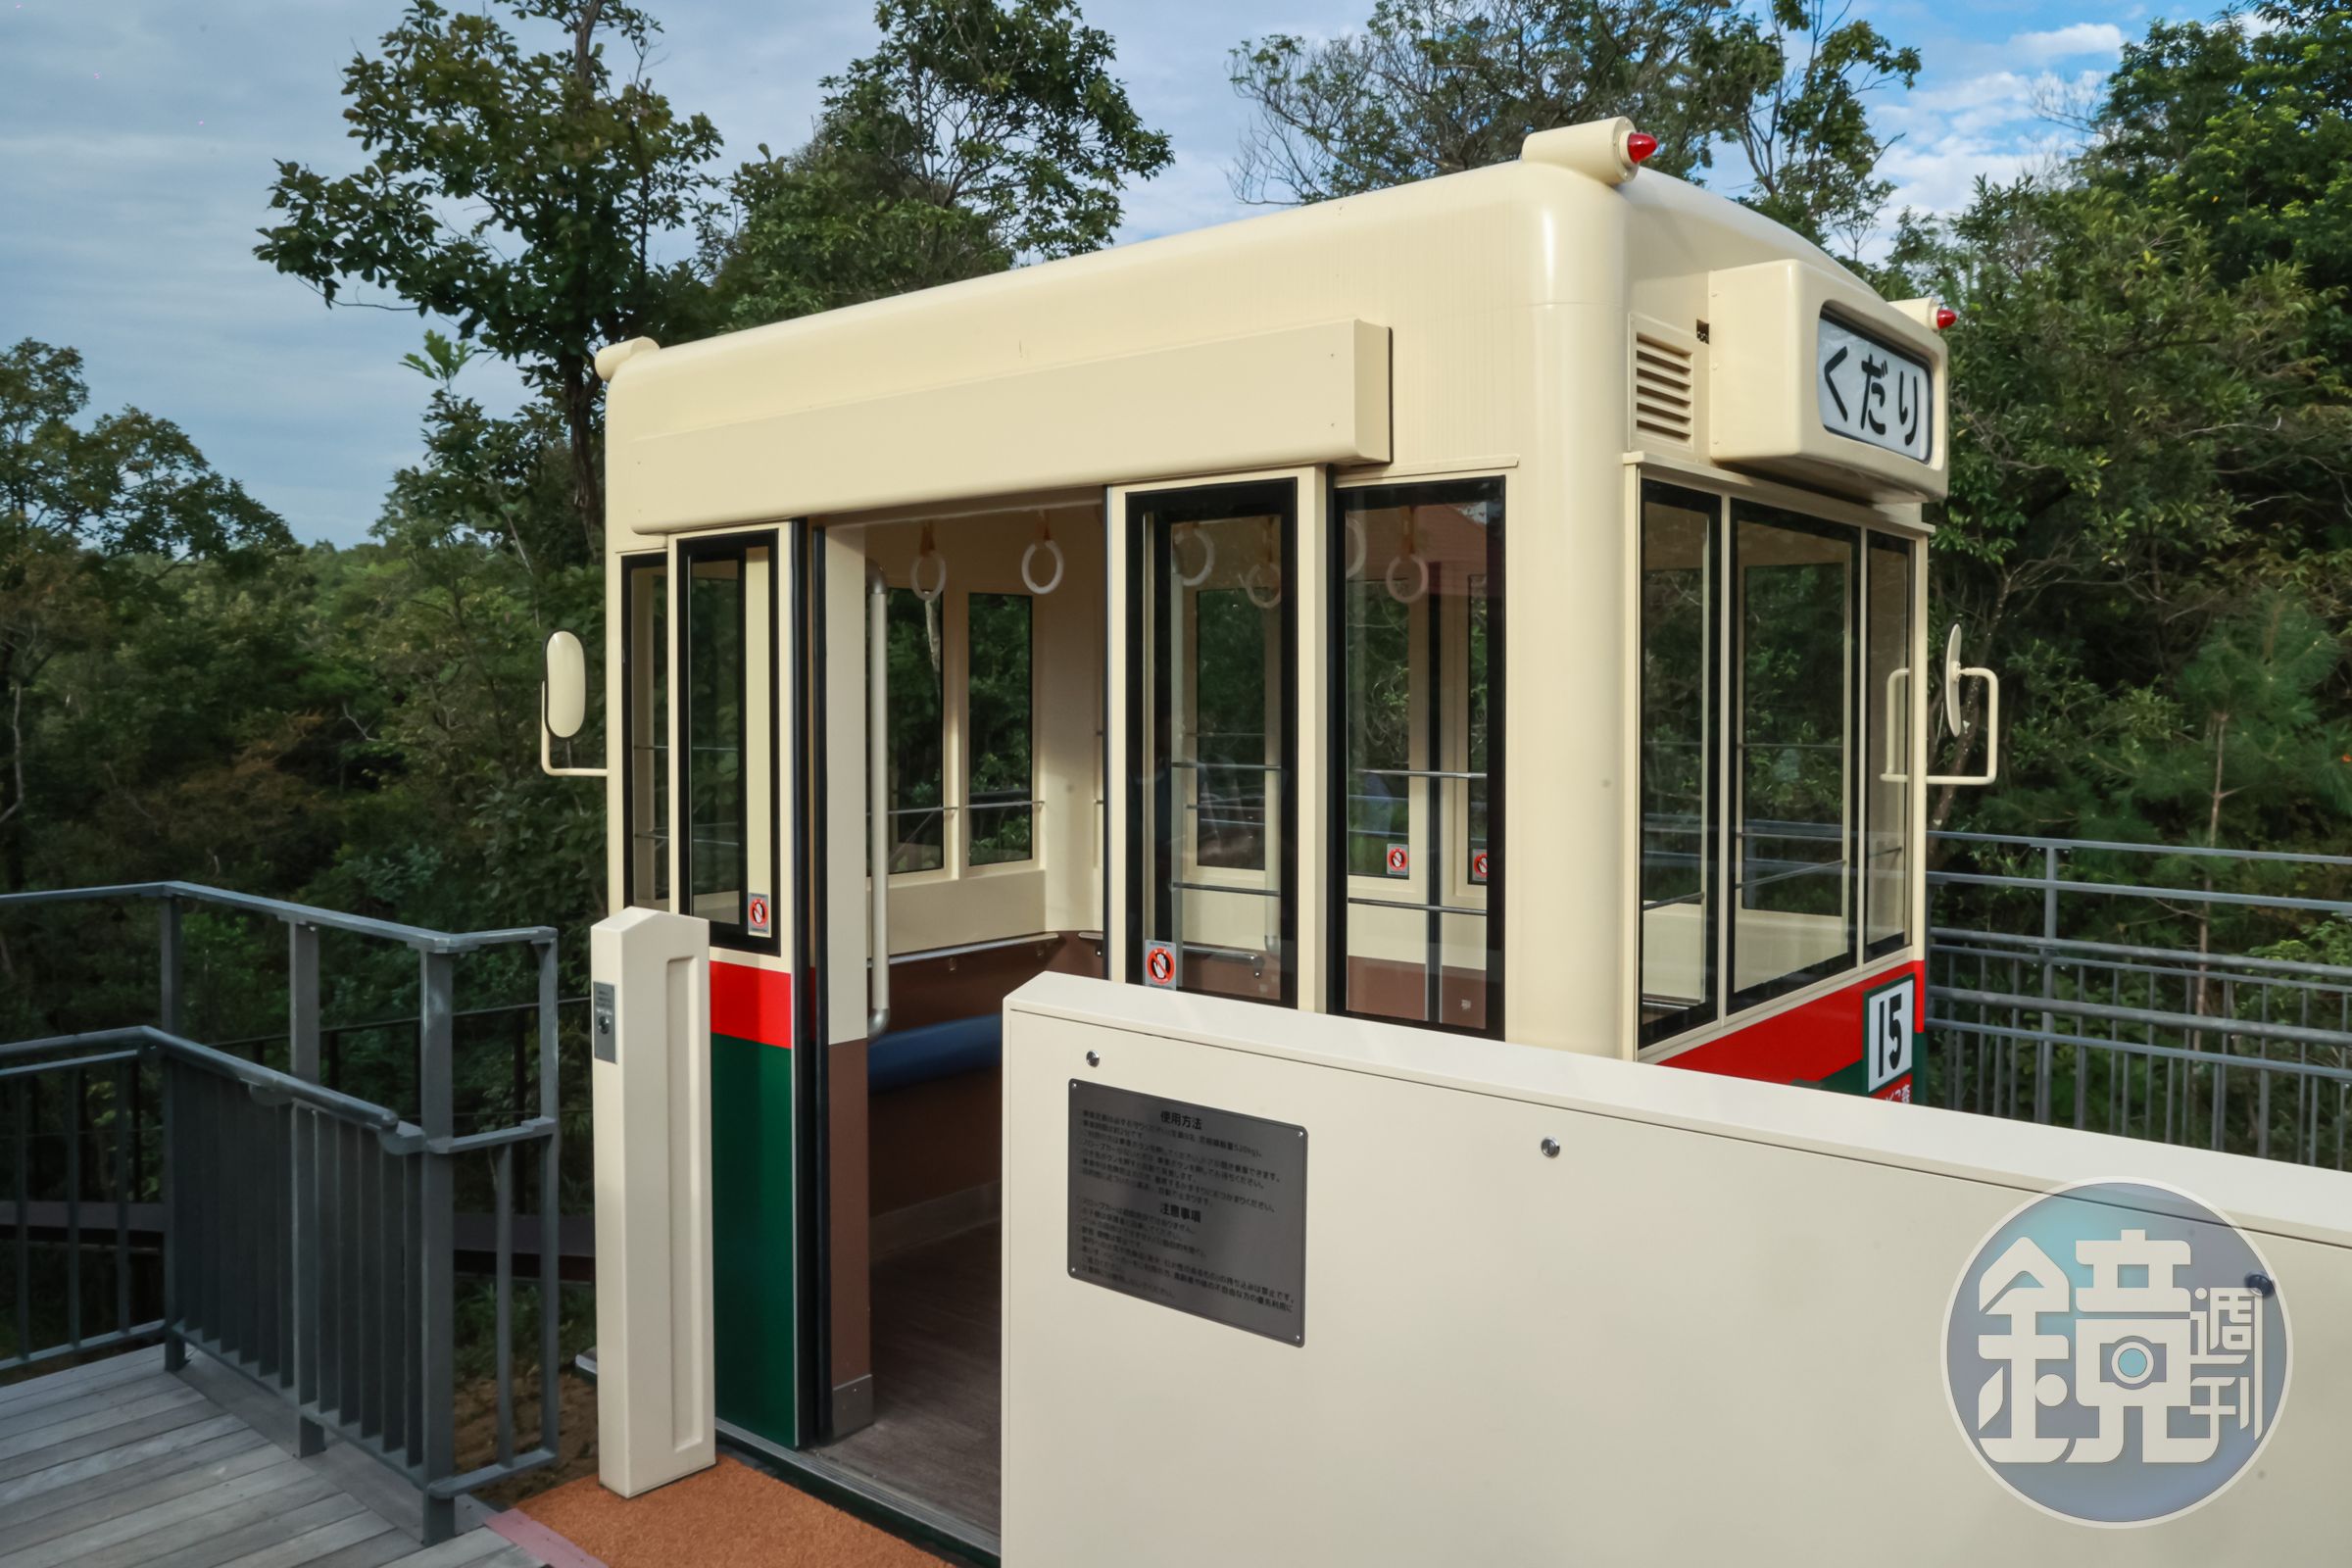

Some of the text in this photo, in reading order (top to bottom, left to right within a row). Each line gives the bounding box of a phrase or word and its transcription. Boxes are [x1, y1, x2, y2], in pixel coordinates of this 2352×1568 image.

[1824, 345, 1918, 447] くだり
[1878, 993, 1902, 1079] 15
[1160, 1109, 1202, 1131] 使用方法
